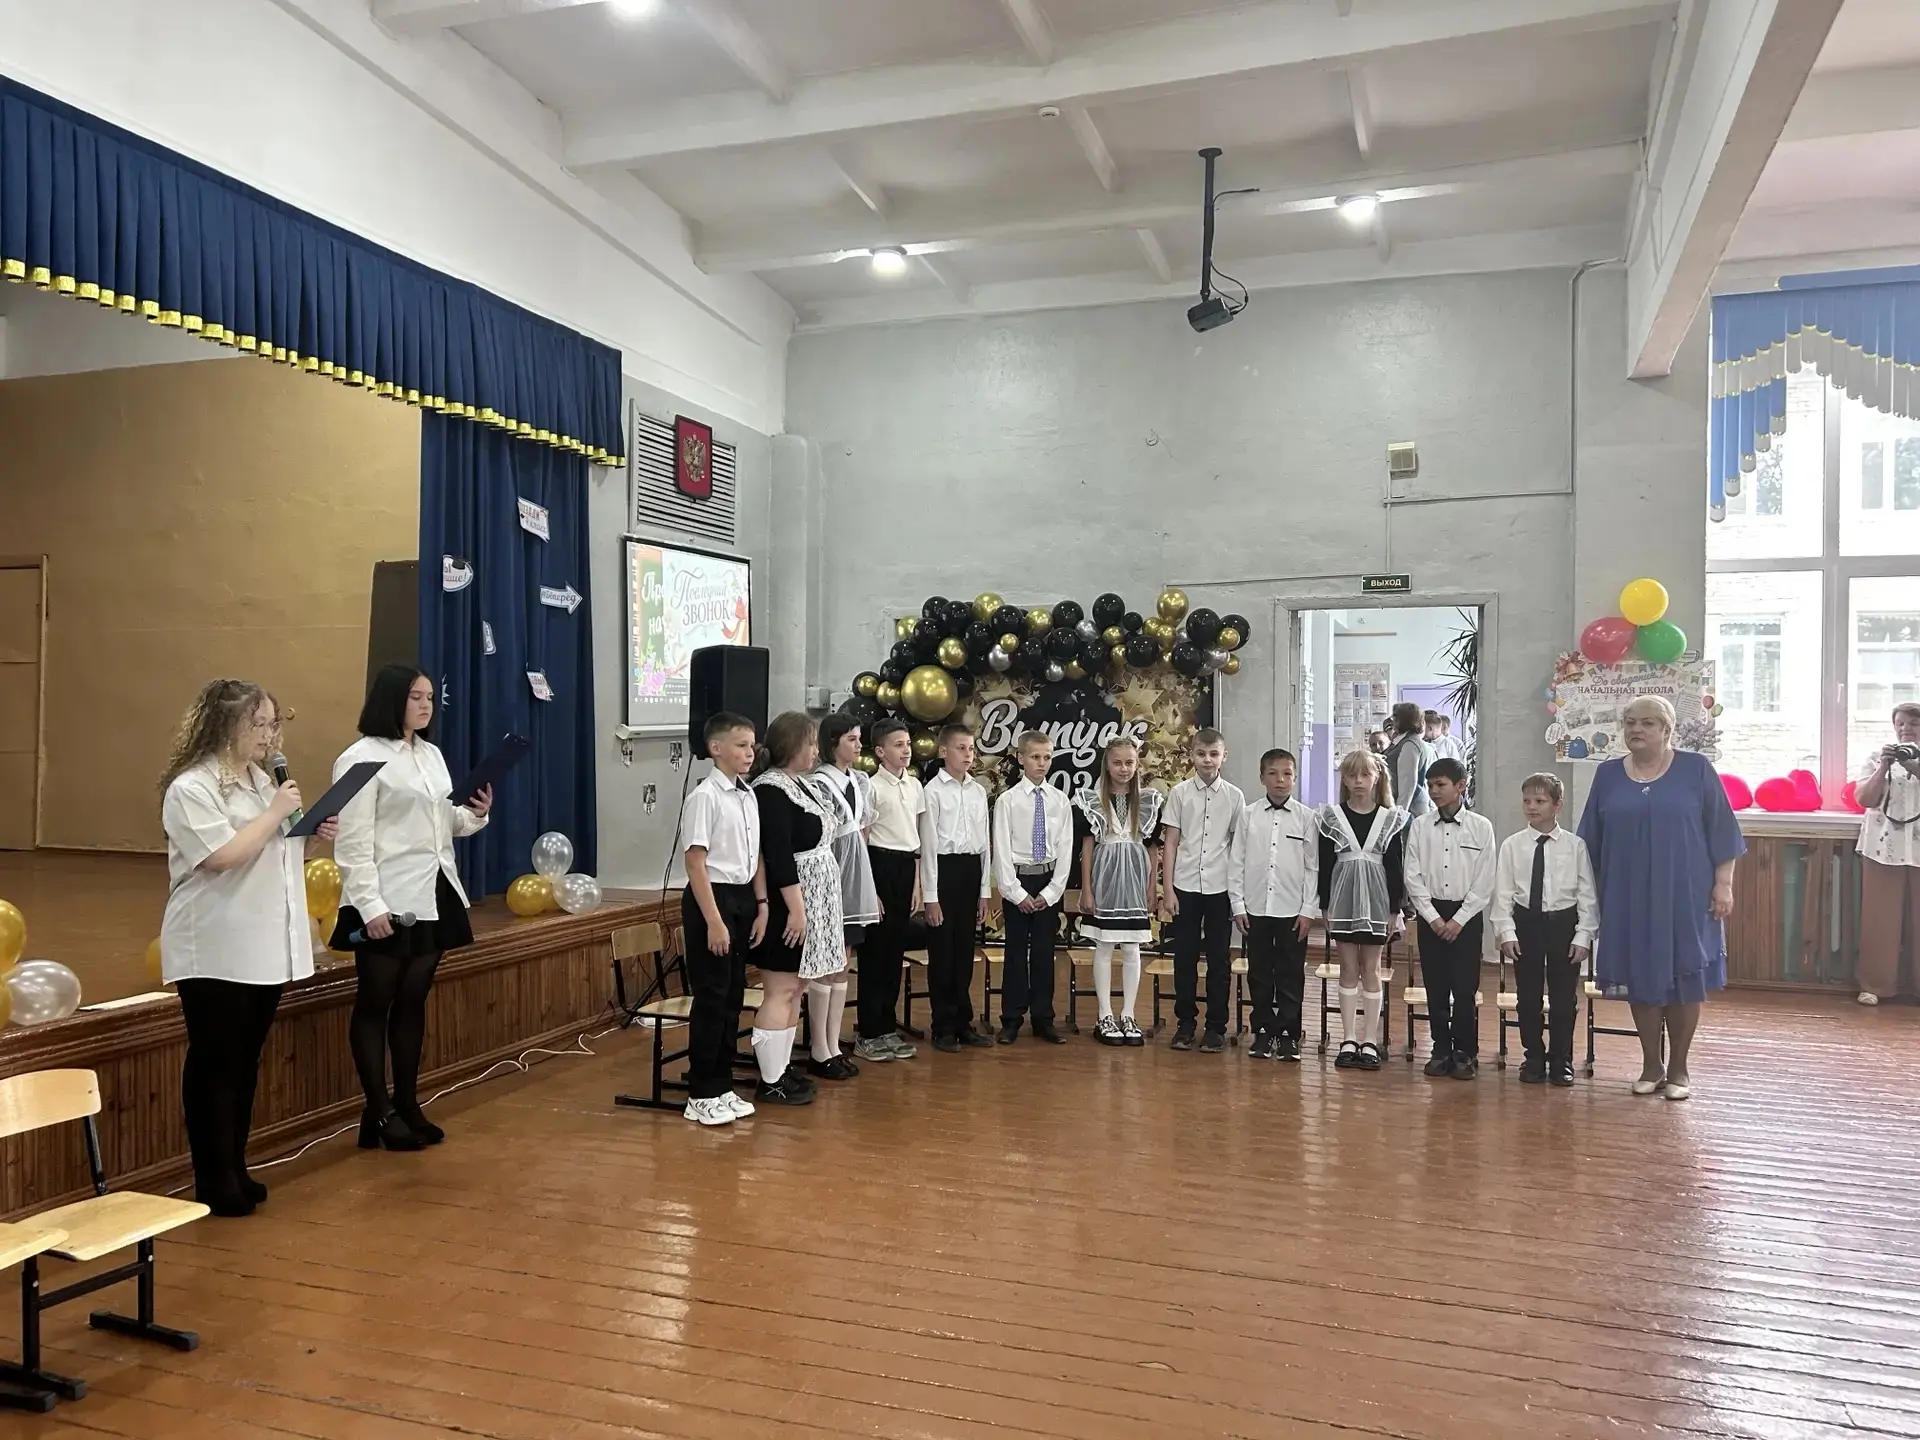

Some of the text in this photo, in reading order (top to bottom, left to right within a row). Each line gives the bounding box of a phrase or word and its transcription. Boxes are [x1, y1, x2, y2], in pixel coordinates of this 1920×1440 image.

[1370, 578, 1402, 587] ВЫХОД
[683, 599, 731, 626] ЗВОНОК
[1590, 674, 1609, 687] До
[1577, 685, 1674, 695] НАЧАЛЬНАЯ ШКОЛА
